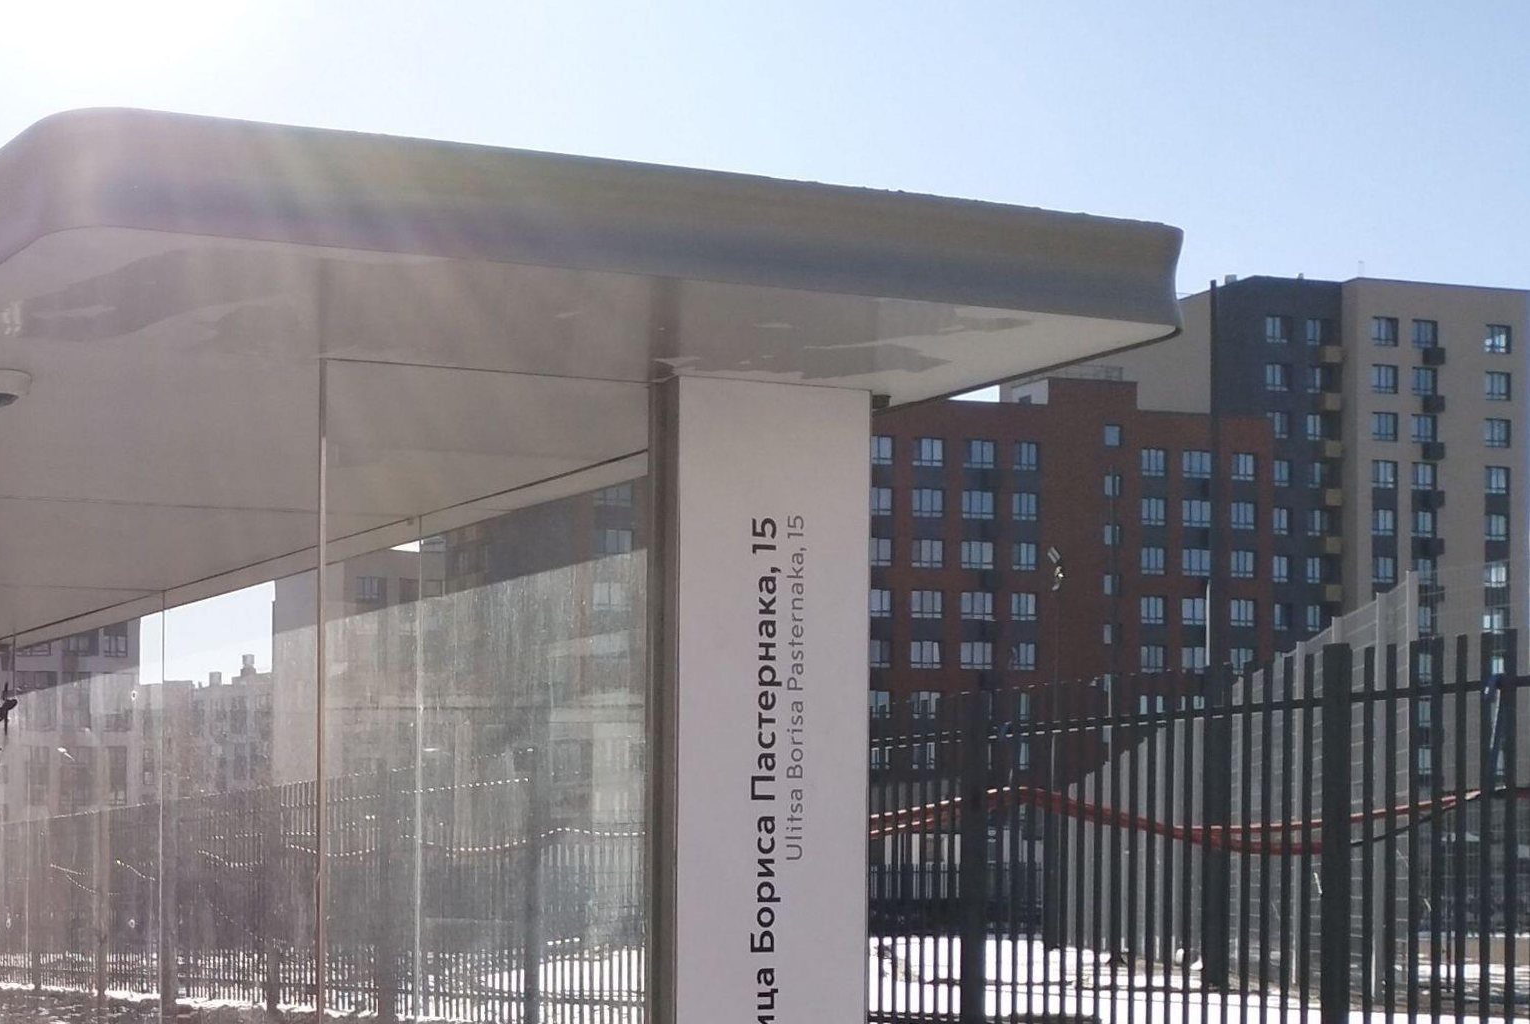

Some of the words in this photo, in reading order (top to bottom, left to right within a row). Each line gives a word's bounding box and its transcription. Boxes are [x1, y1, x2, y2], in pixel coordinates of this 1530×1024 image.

[751, 517, 777, 554] 15
[787, 515, 804, 538] 15
[786, 547, 807, 691] Pasternaka,
[750, 566, 782, 801] Пастернака,
[786, 700, 804, 779] Borisa
[784, 788, 803, 861] Ulitsa
[749, 815, 782, 953] Бориса
